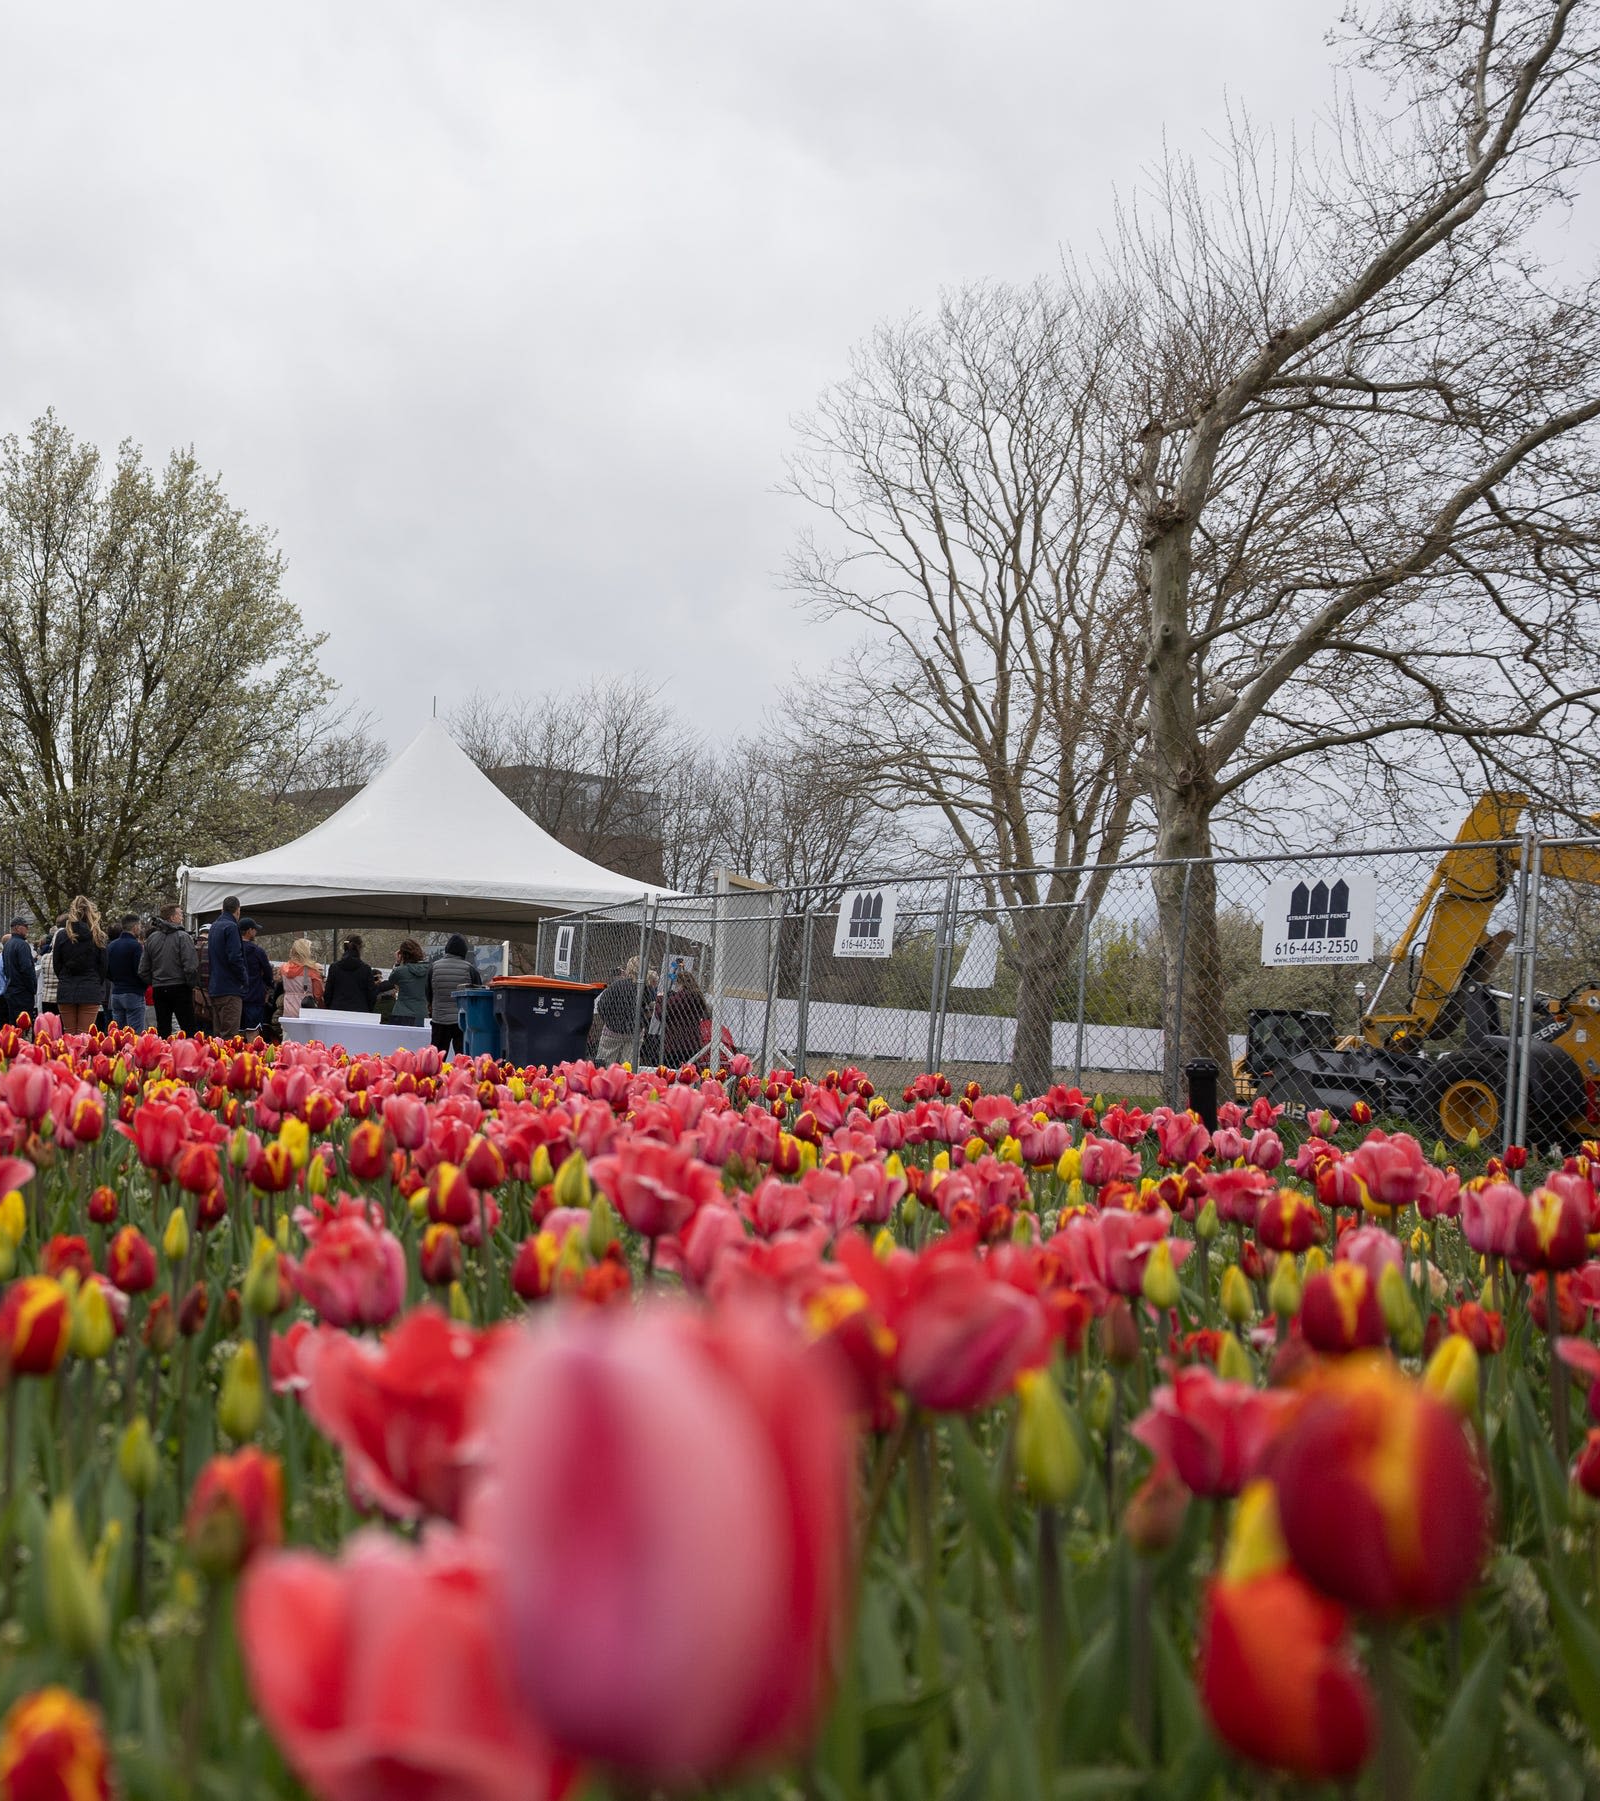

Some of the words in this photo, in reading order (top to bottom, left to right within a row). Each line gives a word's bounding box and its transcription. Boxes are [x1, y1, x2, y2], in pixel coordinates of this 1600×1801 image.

[841, 939, 885, 950] 616-443-2550
[1275, 939, 1358, 956] 616-443-2550
[1273, 955, 1360, 964] www.straightlinefences.com
[1531, 1021, 1568, 1040] EERE
